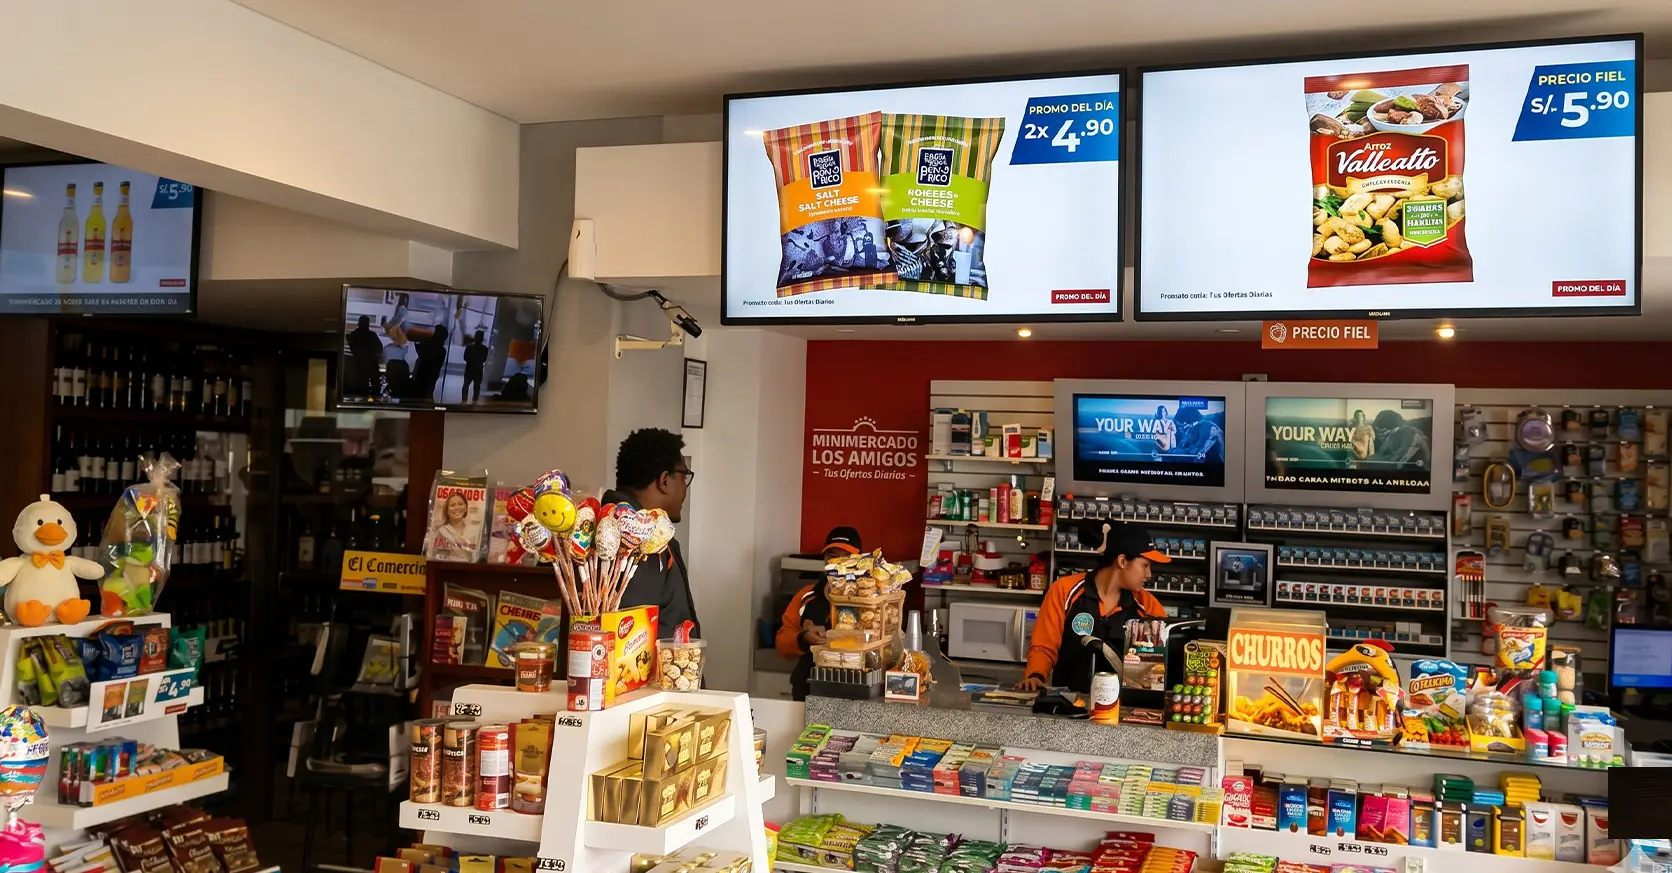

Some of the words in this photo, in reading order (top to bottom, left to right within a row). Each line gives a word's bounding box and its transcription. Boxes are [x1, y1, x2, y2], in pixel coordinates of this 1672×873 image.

[1538, 73, 1592, 86] PRECIO
[1595, 71, 1626, 82] FIEL
[1029, 104, 1069, 115] PROMO
[1071, 102, 1093, 113] DEL
[1095, 99, 1114, 111] DÍA
[1561, 91, 1630, 128] 5.90
[1024, 123, 1049, 139] 2x
[1051, 118, 1114, 153] 4.90
[1364, 142, 1392, 151] Arroz
[168, 183, 193, 200] 5.90
[816, 189, 840, 200] SALT
[798, 201, 822, 212] SALT
[823, 195, 860, 207] CHEESE
[910, 197, 955, 208] CHEESE
[1557, 285, 1587, 293] PROMO
[1589, 284, 1605, 292] DEL
[1606, 282, 1621, 291] DÍA
[1292, 326, 1340, 339] PRECIO
[1343, 326, 1371, 339] FIEL
[1095, 417, 1134, 433] YOUR
[812, 434, 918, 449] MINIMERCADO
[1271, 425, 1315, 441] YOUR
[1318, 426, 1357, 442] WAY
[812, 449, 844, 465] LOS
[847, 450, 917, 467] AMIGOS
[823, 468, 838, 477] Tus
[1231, 632, 1322, 672] CHURROS
